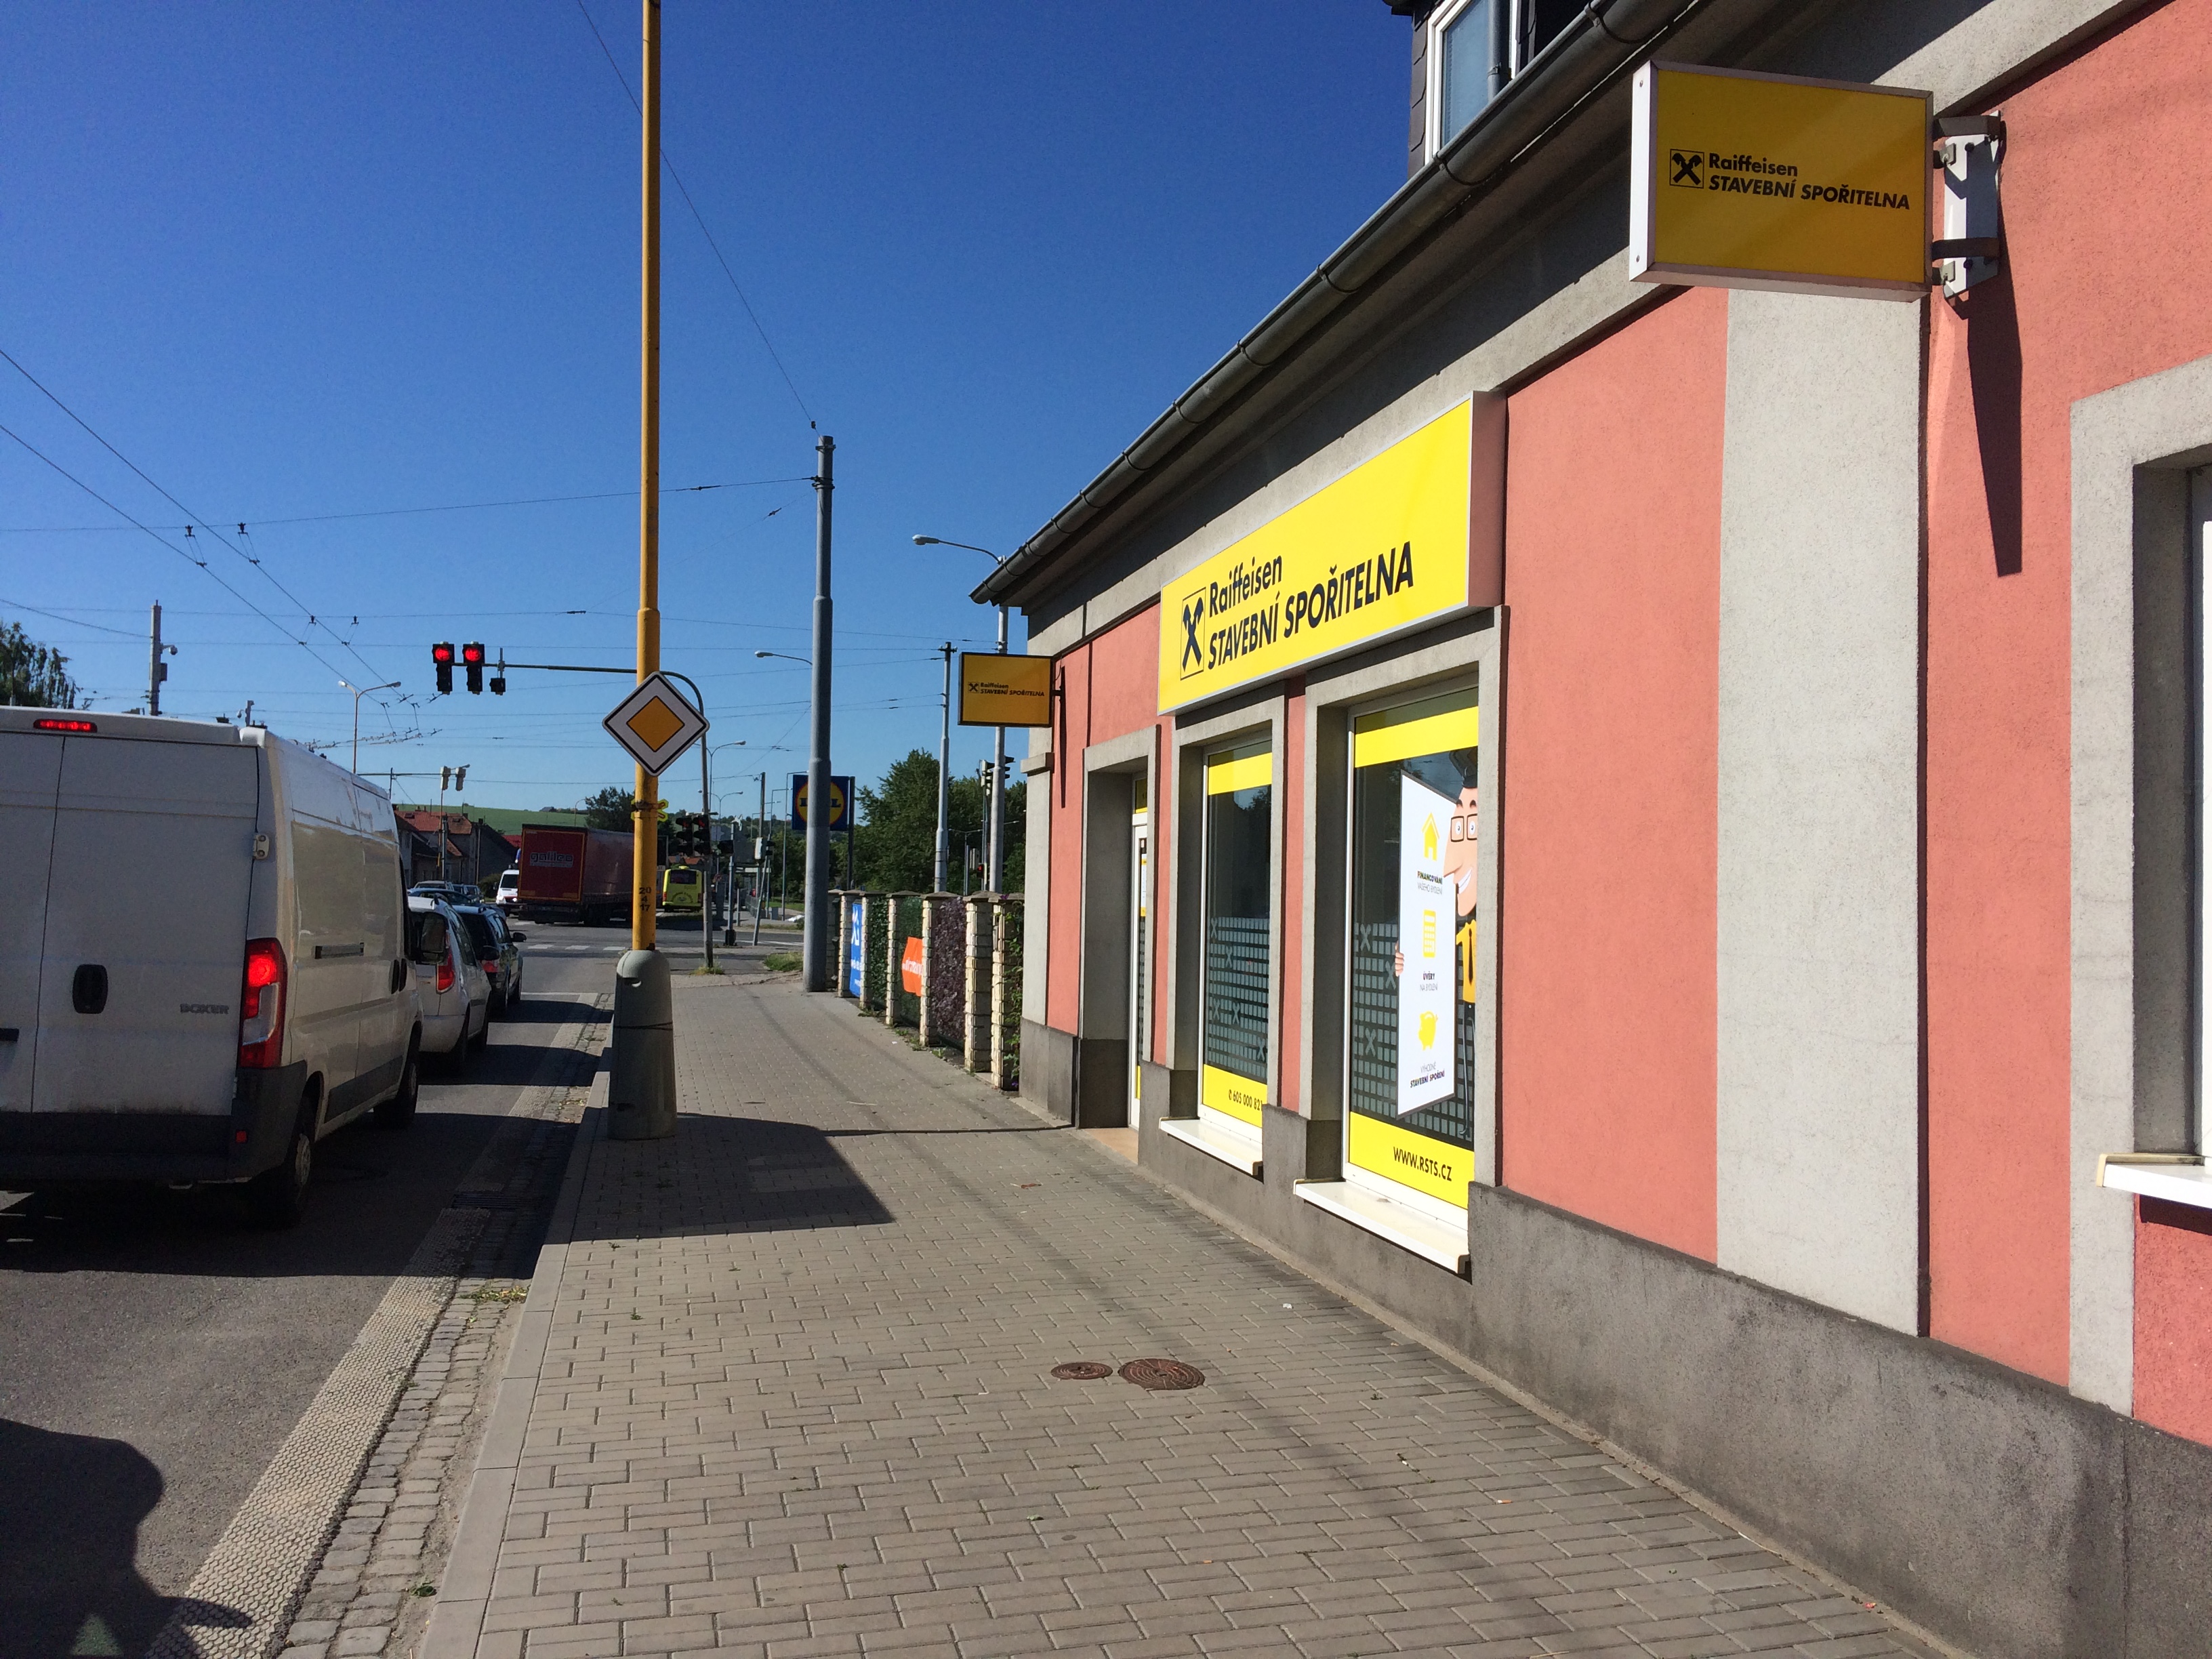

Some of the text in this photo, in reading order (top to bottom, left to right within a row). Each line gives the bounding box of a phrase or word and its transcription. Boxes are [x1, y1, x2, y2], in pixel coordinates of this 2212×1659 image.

[1709, 152, 1798, 176] Raiffeisen
[1708, 174, 1910, 210] STAVEBNÍ SPOŘITELNA
[1209, 555, 1282, 618] Raiffeisen
[1208, 541, 1414, 670] STAVEBNÍ SPOŘITELNA
[800, 798, 841, 808] LL
[639, 886, 652, 895] 20
[180, 1003, 230, 1015] BOXER
[1233, 1090, 1242, 1104] 605
[1243, 1093, 1252, 1108] 000
[1393, 1146, 1452, 1182] WWW.RSTS.CZ
